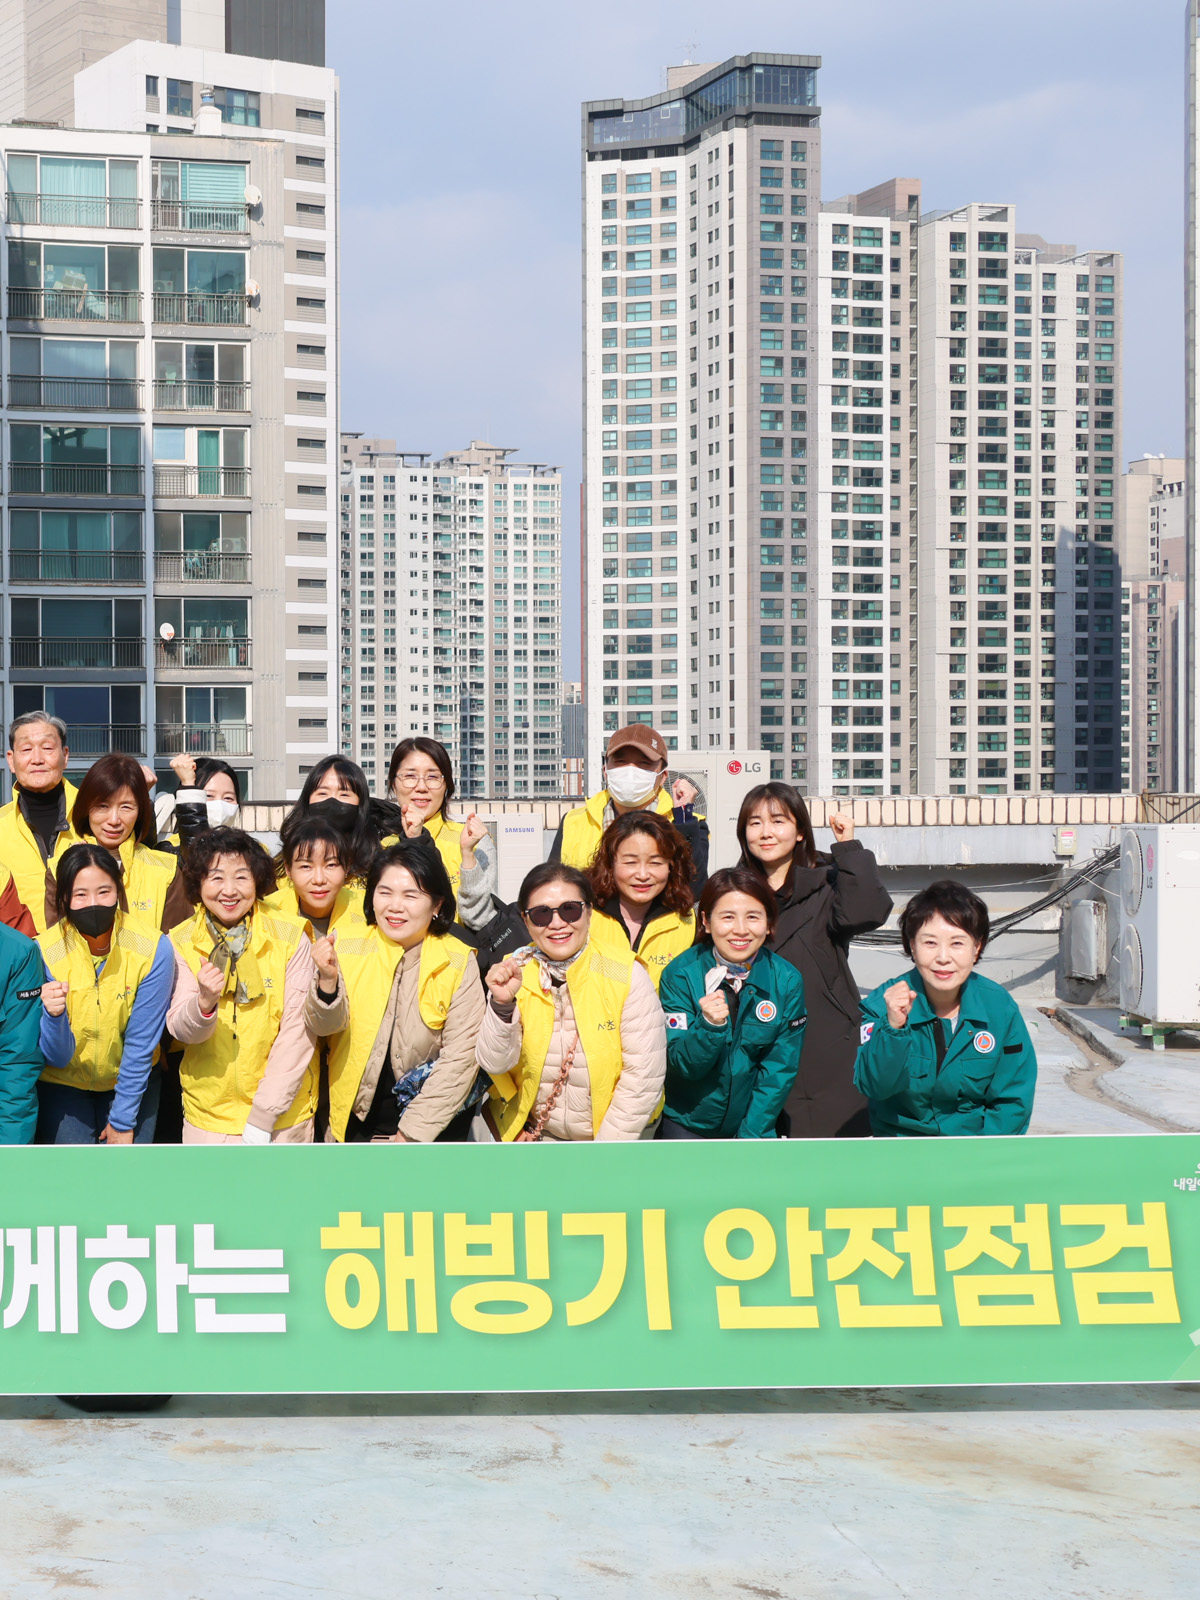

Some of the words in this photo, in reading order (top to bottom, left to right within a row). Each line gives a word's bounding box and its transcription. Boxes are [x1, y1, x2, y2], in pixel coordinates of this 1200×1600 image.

[744, 762, 762, 773] LG
[647, 955, 667, 966] 서초
[320, 1208, 673, 1335] 해빙기
[703, 1201, 1182, 1330] 안전점검
